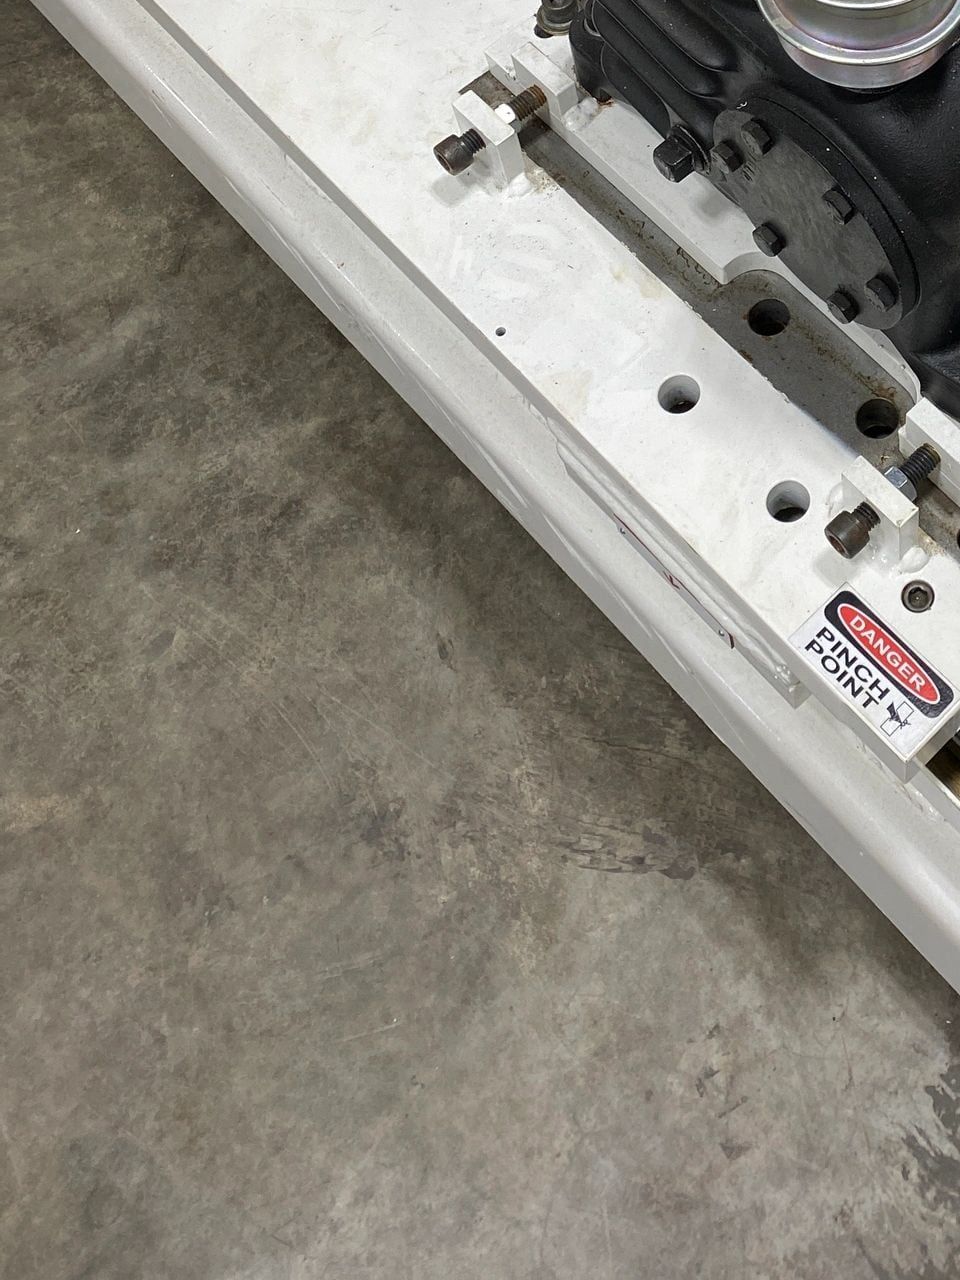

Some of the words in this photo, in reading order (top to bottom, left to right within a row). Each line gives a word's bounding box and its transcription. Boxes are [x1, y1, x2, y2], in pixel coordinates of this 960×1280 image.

[804, 639, 880, 709] POINT
[816, 626, 891, 701] PINCH
[850, 615, 927, 692] DANGER
